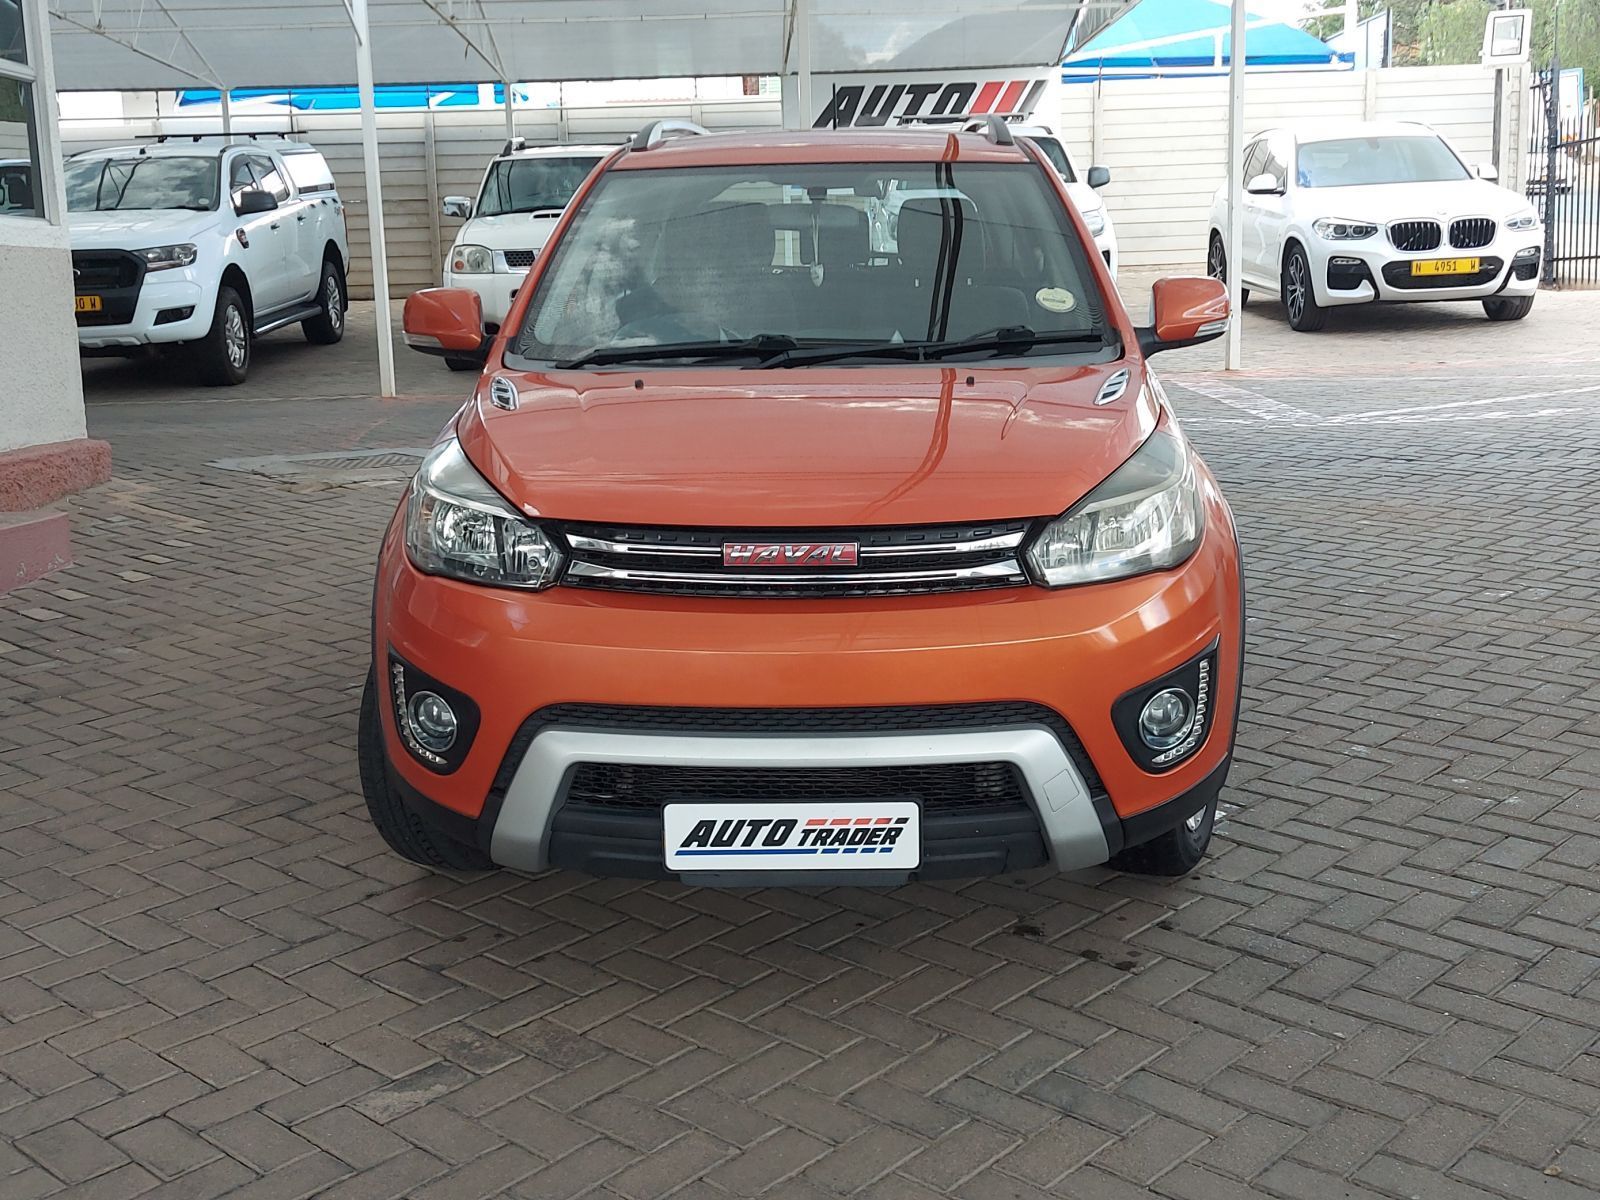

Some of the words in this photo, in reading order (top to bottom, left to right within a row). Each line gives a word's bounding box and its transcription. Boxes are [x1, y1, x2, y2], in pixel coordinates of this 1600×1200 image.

[812, 82, 978, 127] AUTO
[1415, 262, 1422, 273] N
[1434, 260, 1457, 273] 4951
[1470, 259, 1476, 271] W
[89, 297, 97, 309] W
[730, 545, 853, 563] HAVAL
[680, 819, 798, 848] AUTO
[798, 826, 904, 847] TRADER
